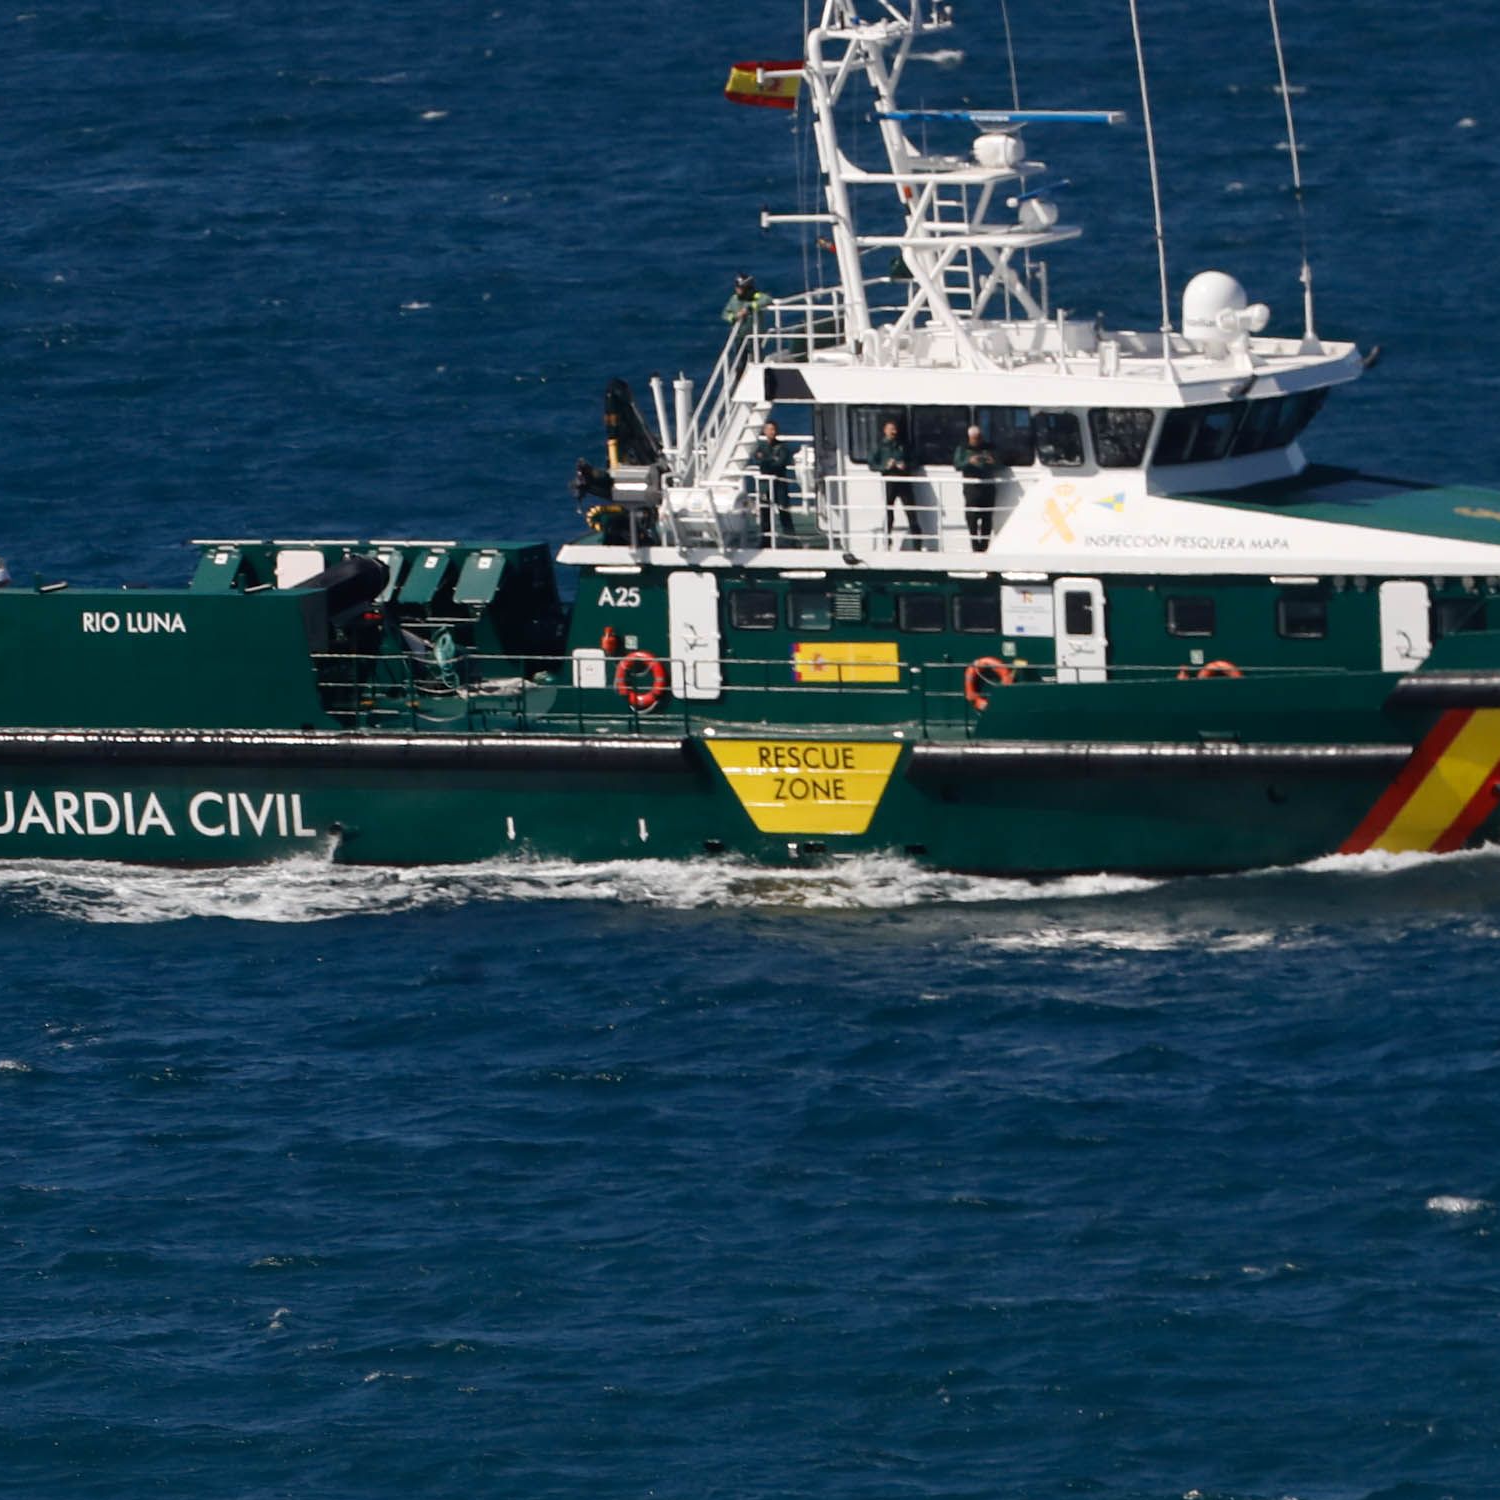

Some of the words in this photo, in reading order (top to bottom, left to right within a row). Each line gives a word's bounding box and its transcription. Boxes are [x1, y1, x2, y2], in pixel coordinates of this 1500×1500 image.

[1083, 533, 1170, 549] INSPECCIÓN
[1173, 535, 1246, 550] PESQUERA
[1250, 537, 1291, 551] MAPA
[82, 611, 120, 633] RIO
[126, 611, 187, 633] LUNA
[758, 746, 855, 769] RESCUE
[773, 777, 846, 800] ZONE
[188, 791, 317, 838] CIVIL
